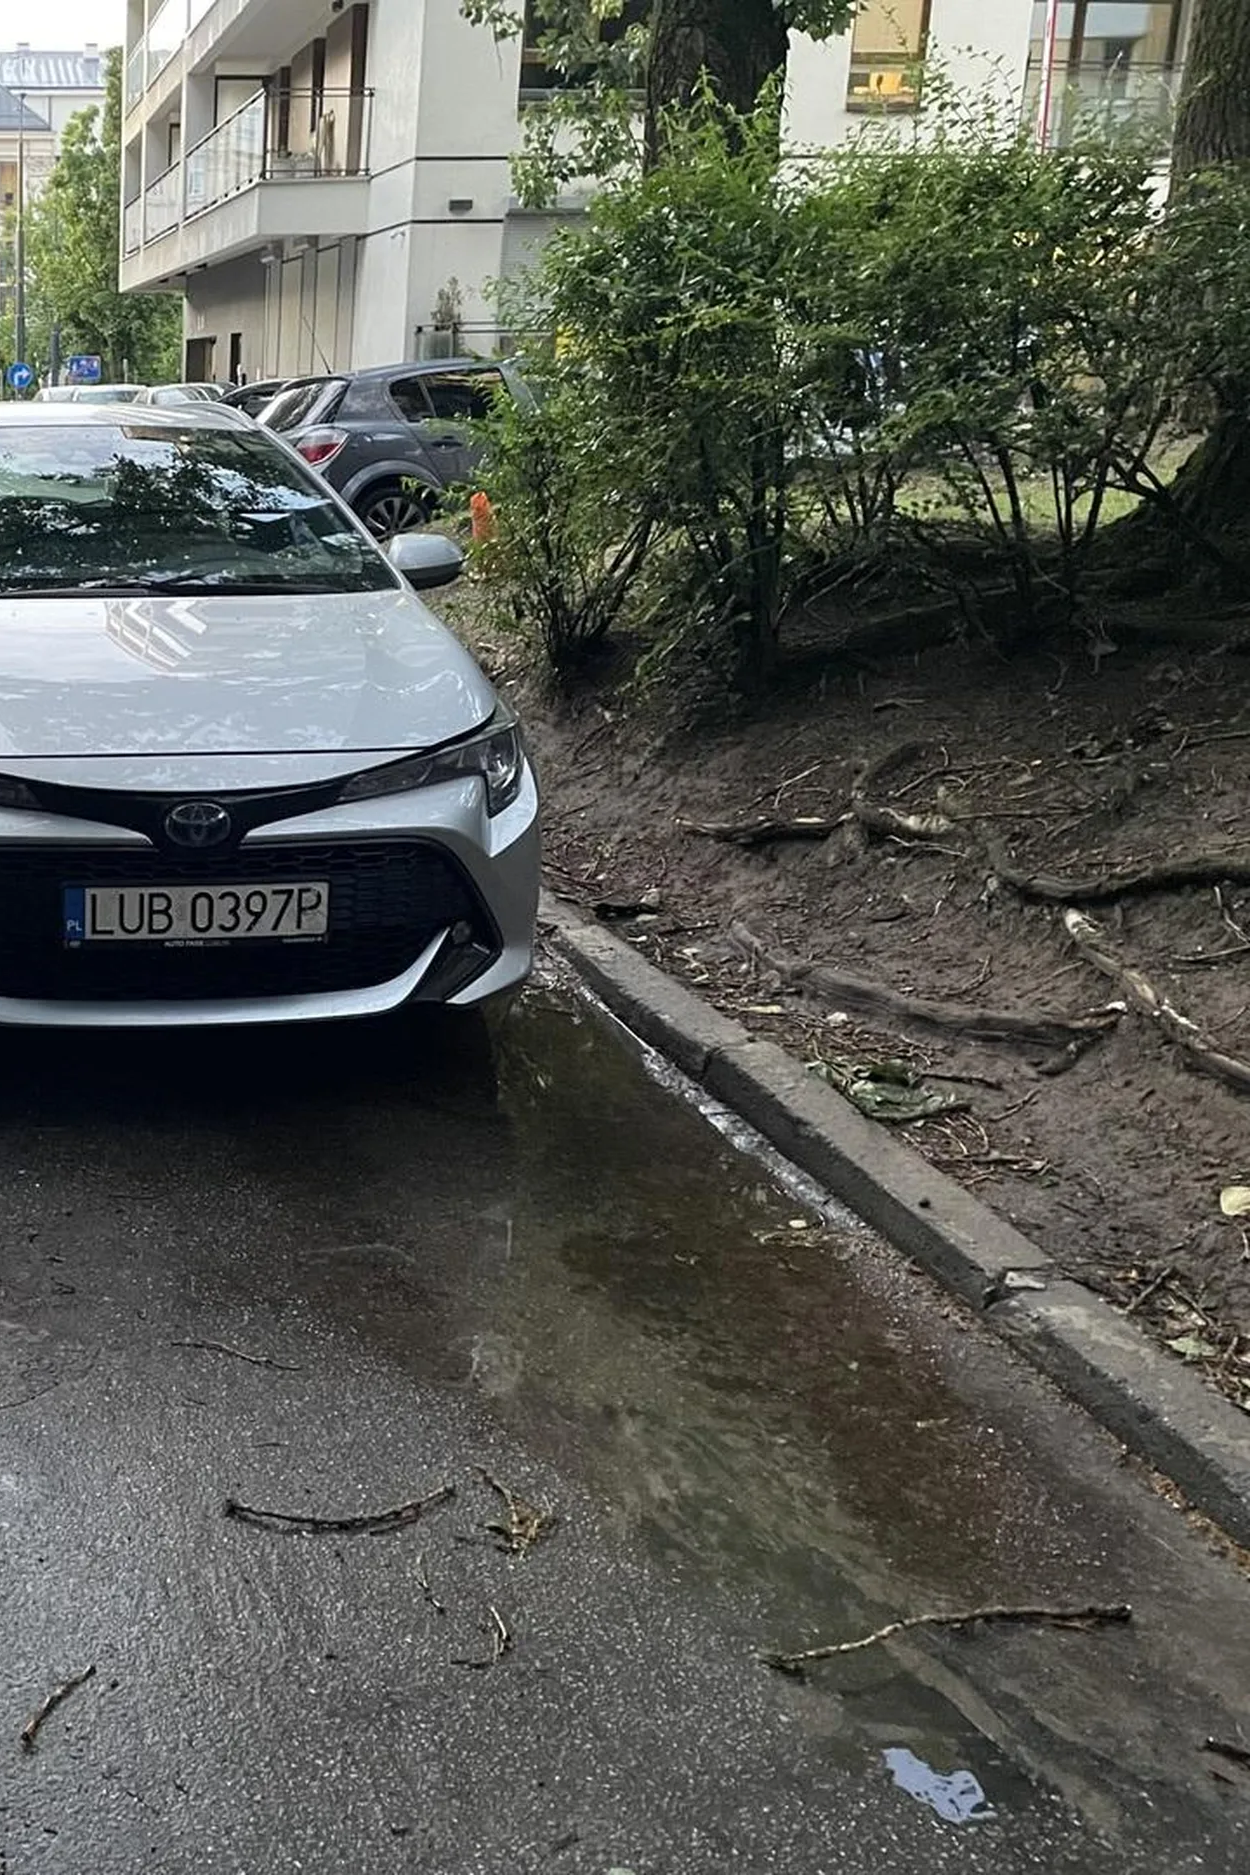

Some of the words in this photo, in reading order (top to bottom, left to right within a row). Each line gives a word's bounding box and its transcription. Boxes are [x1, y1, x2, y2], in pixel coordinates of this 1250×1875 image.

[67, 919, 82, 931] PL
[91, 893, 174, 934] LUB
[191, 888, 321, 932] 0397P
